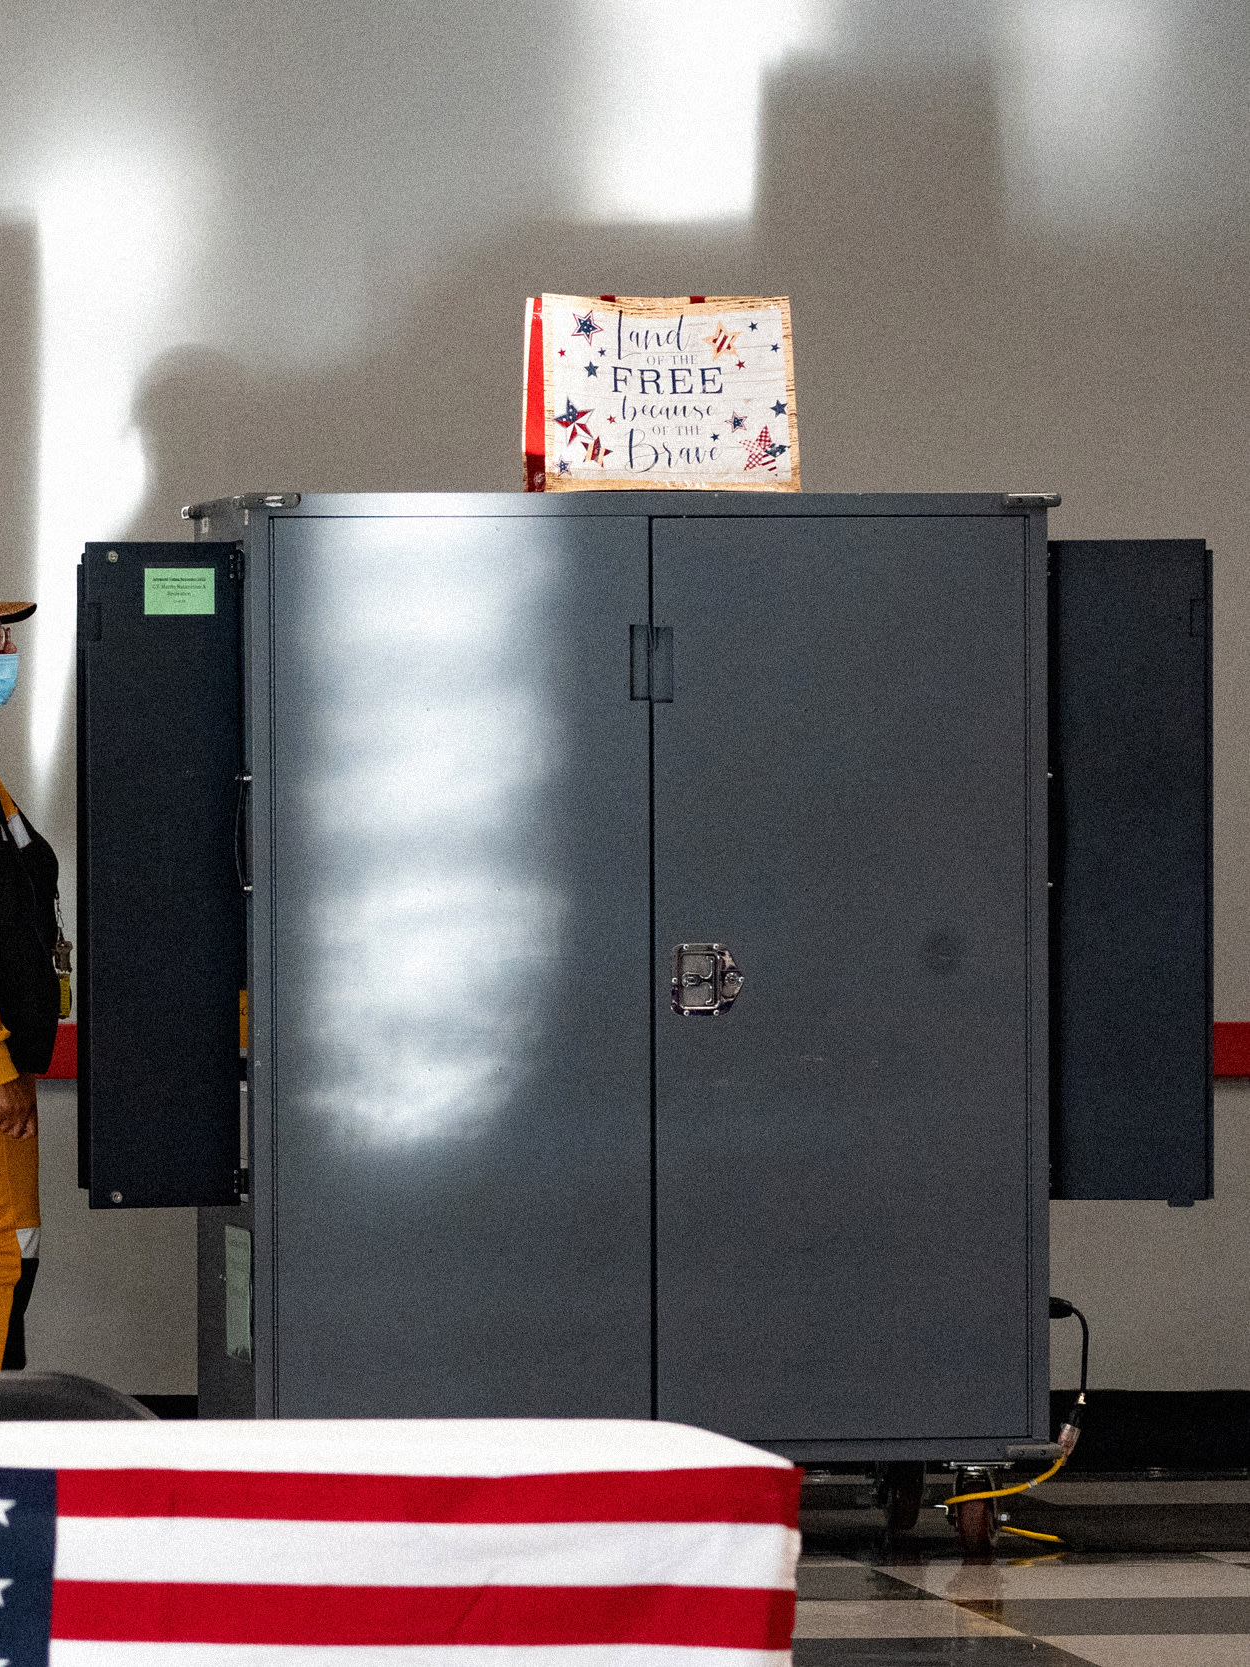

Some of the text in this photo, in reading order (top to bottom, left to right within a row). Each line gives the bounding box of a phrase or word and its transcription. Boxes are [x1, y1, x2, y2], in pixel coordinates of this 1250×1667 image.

[617, 310, 691, 360] Land
[646, 354, 699, 365] OF THE
[611, 366, 723, 395] FREE
[622, 395, 713, 422] because
[652, 425, 702, 436] OF THE
[623, 428, 723, 473] Brave
